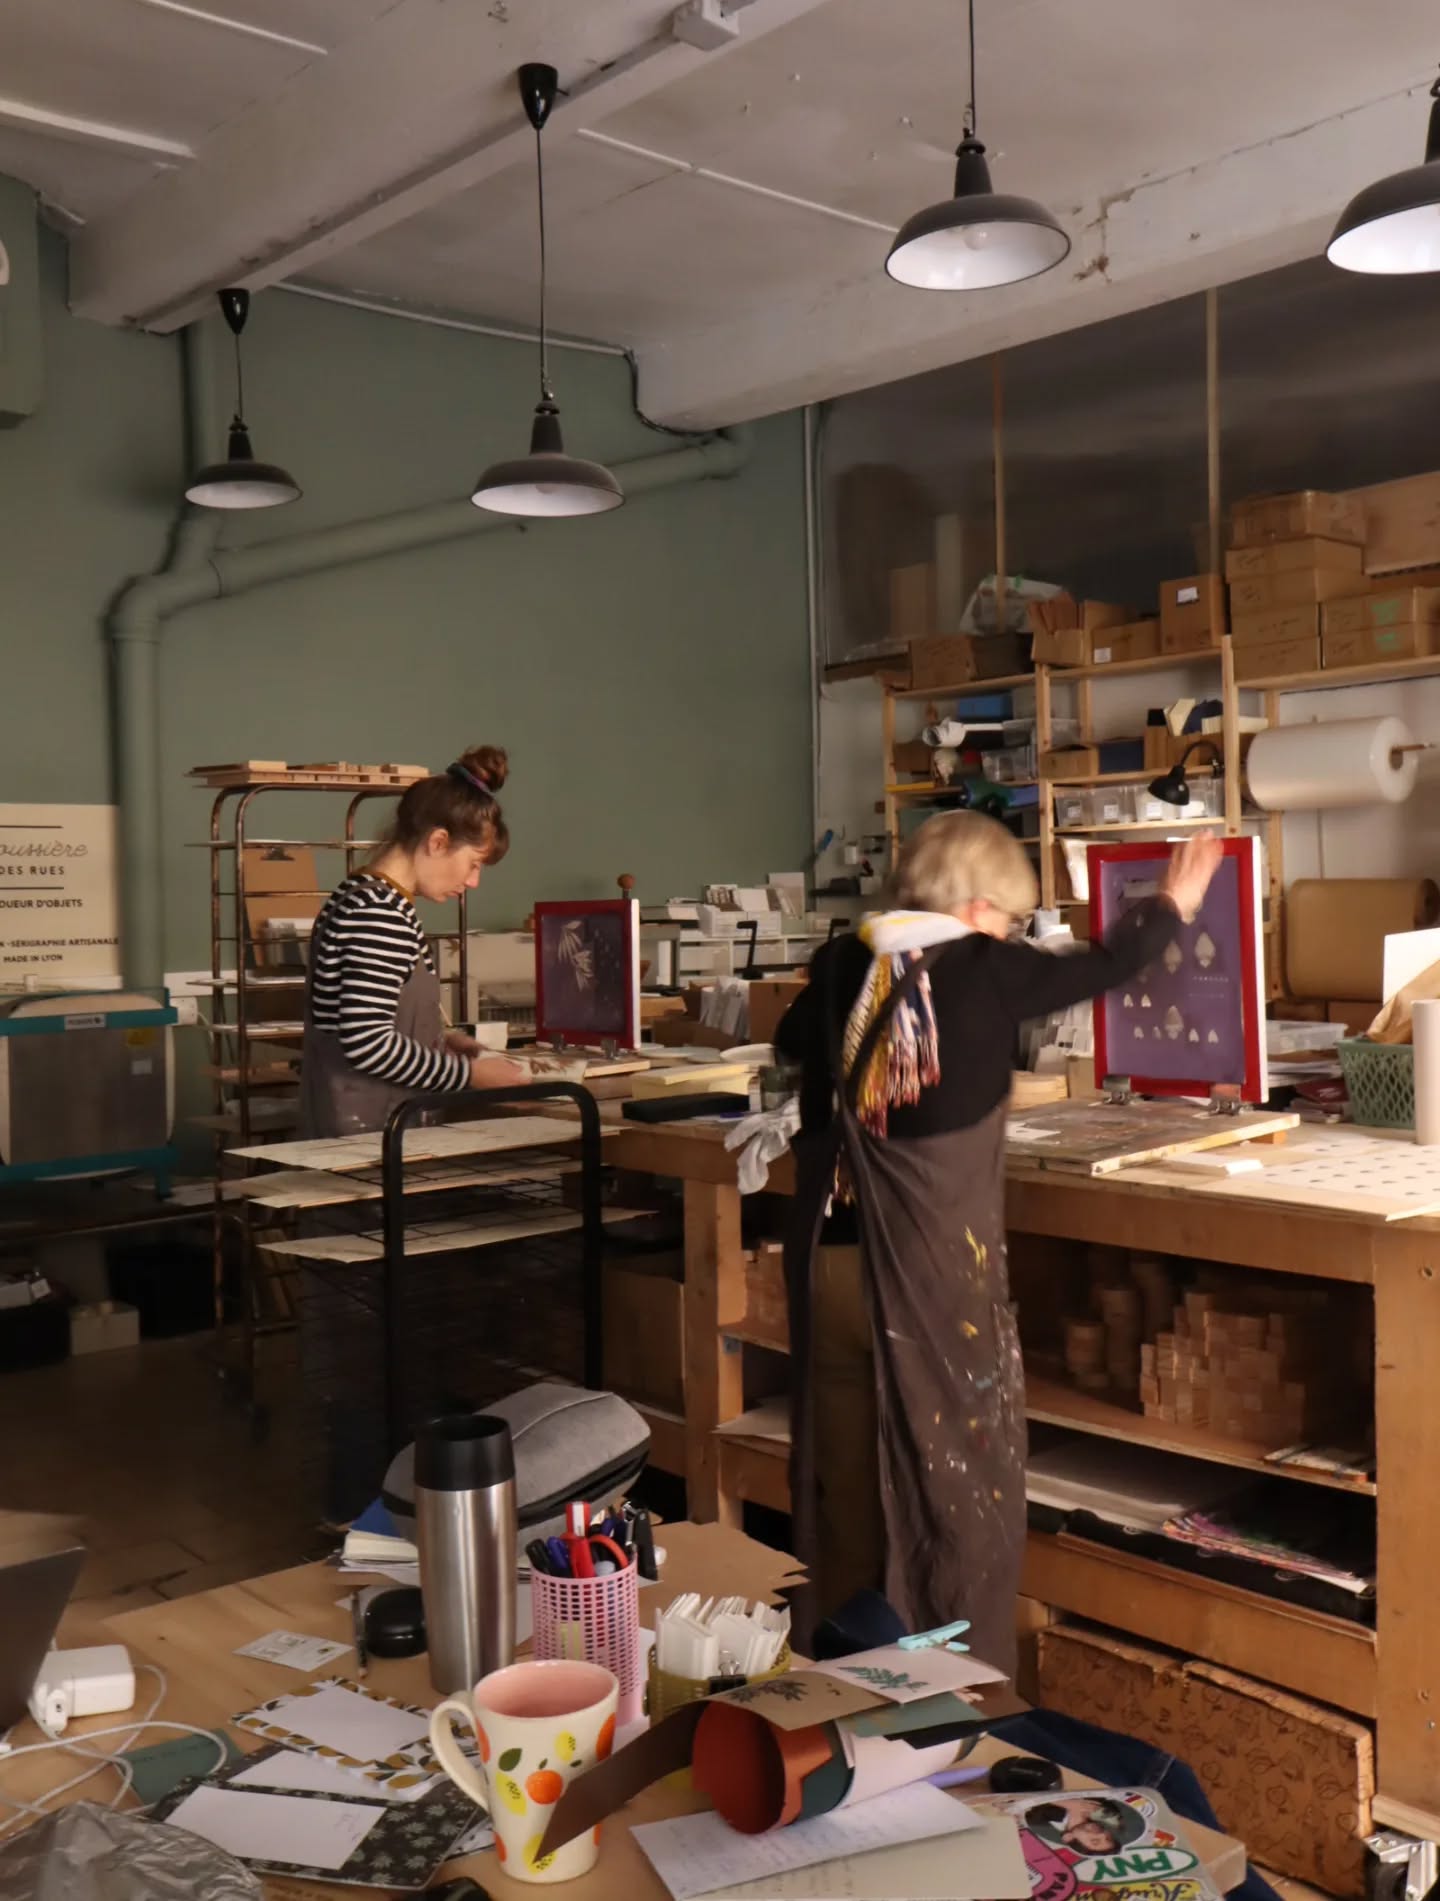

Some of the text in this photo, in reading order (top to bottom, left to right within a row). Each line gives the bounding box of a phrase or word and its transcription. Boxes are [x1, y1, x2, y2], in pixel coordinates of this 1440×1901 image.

[30, 866, 65, 875] RUES
[36, 899, 83, 908] D'OBJETS
[69, 937, 119, 946] ARTISANALE
[3, 955, 28, 963] MADE
[41, 954, 63, 962] LYON
[1092, 1851, 1173, 1881] PNY
